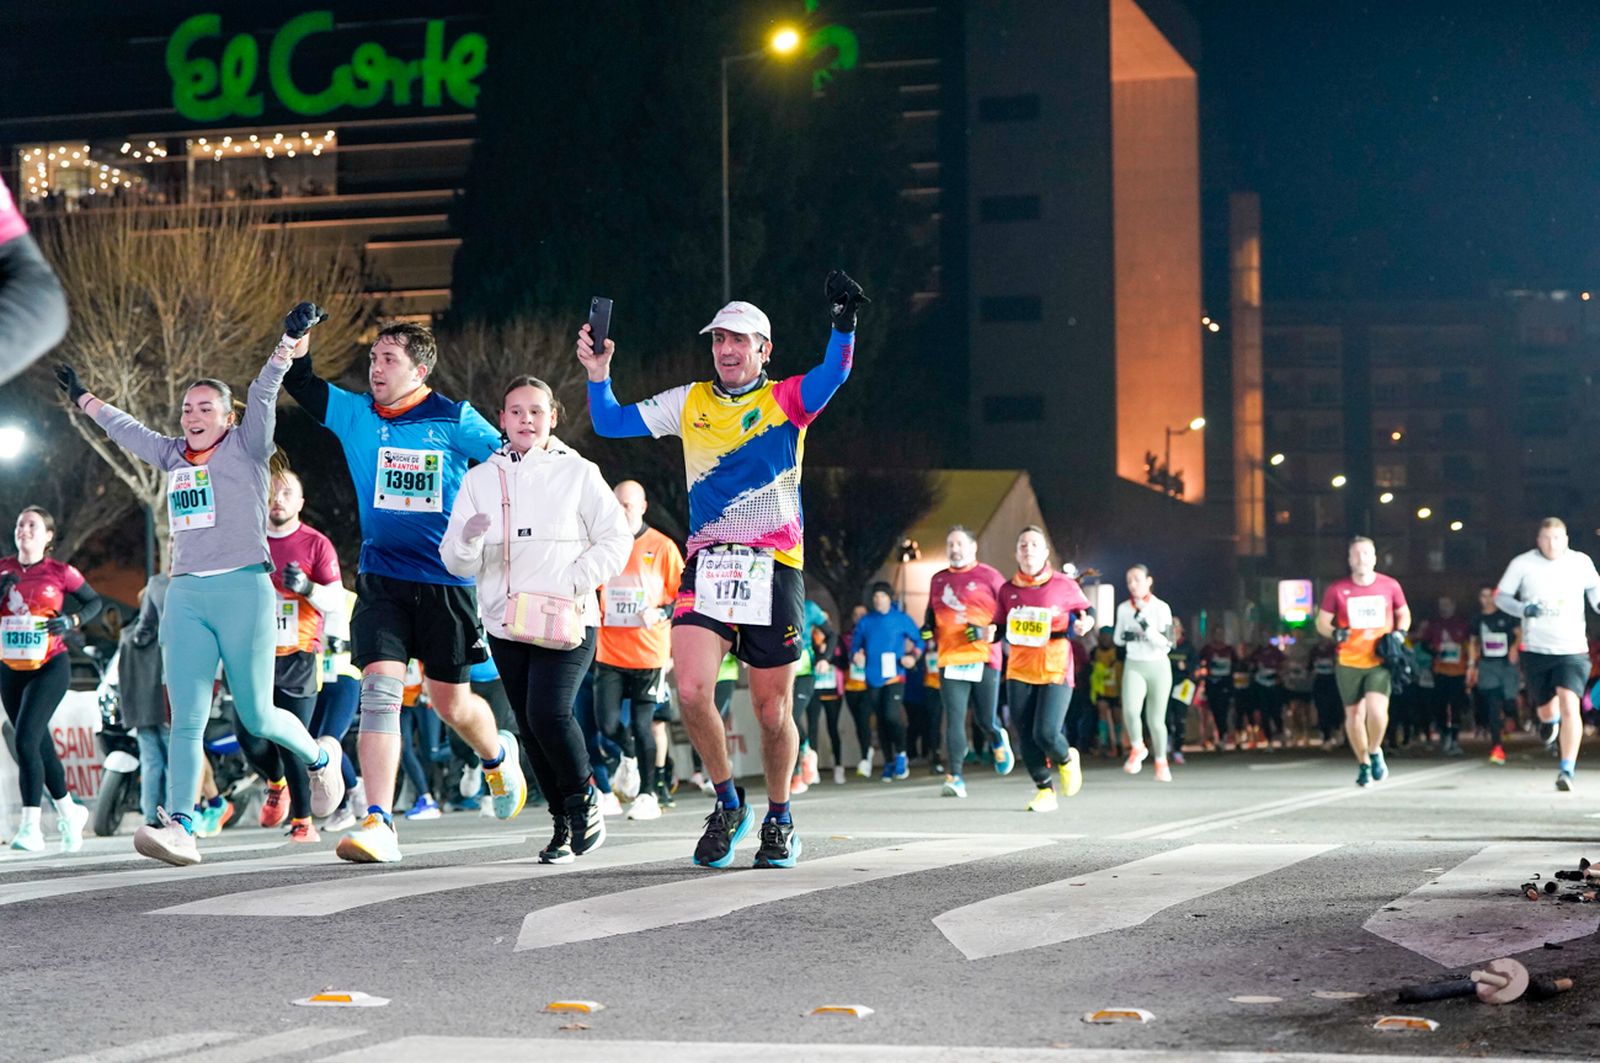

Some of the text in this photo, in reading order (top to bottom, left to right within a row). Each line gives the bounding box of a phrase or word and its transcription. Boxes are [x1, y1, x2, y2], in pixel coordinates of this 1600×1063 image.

[166, 11, 488, 121] El Corte
[385, 469, 434, 491] 13981
[172, 488, 207, 510] 14001
[714, 579, 752, 601] 1176
[616, 602, 637, 614] 1217
[1015, 620, 1043, 633] 2056
[6, 631, 41, 645] 13165
[53, 727, 95, 759] SAN
